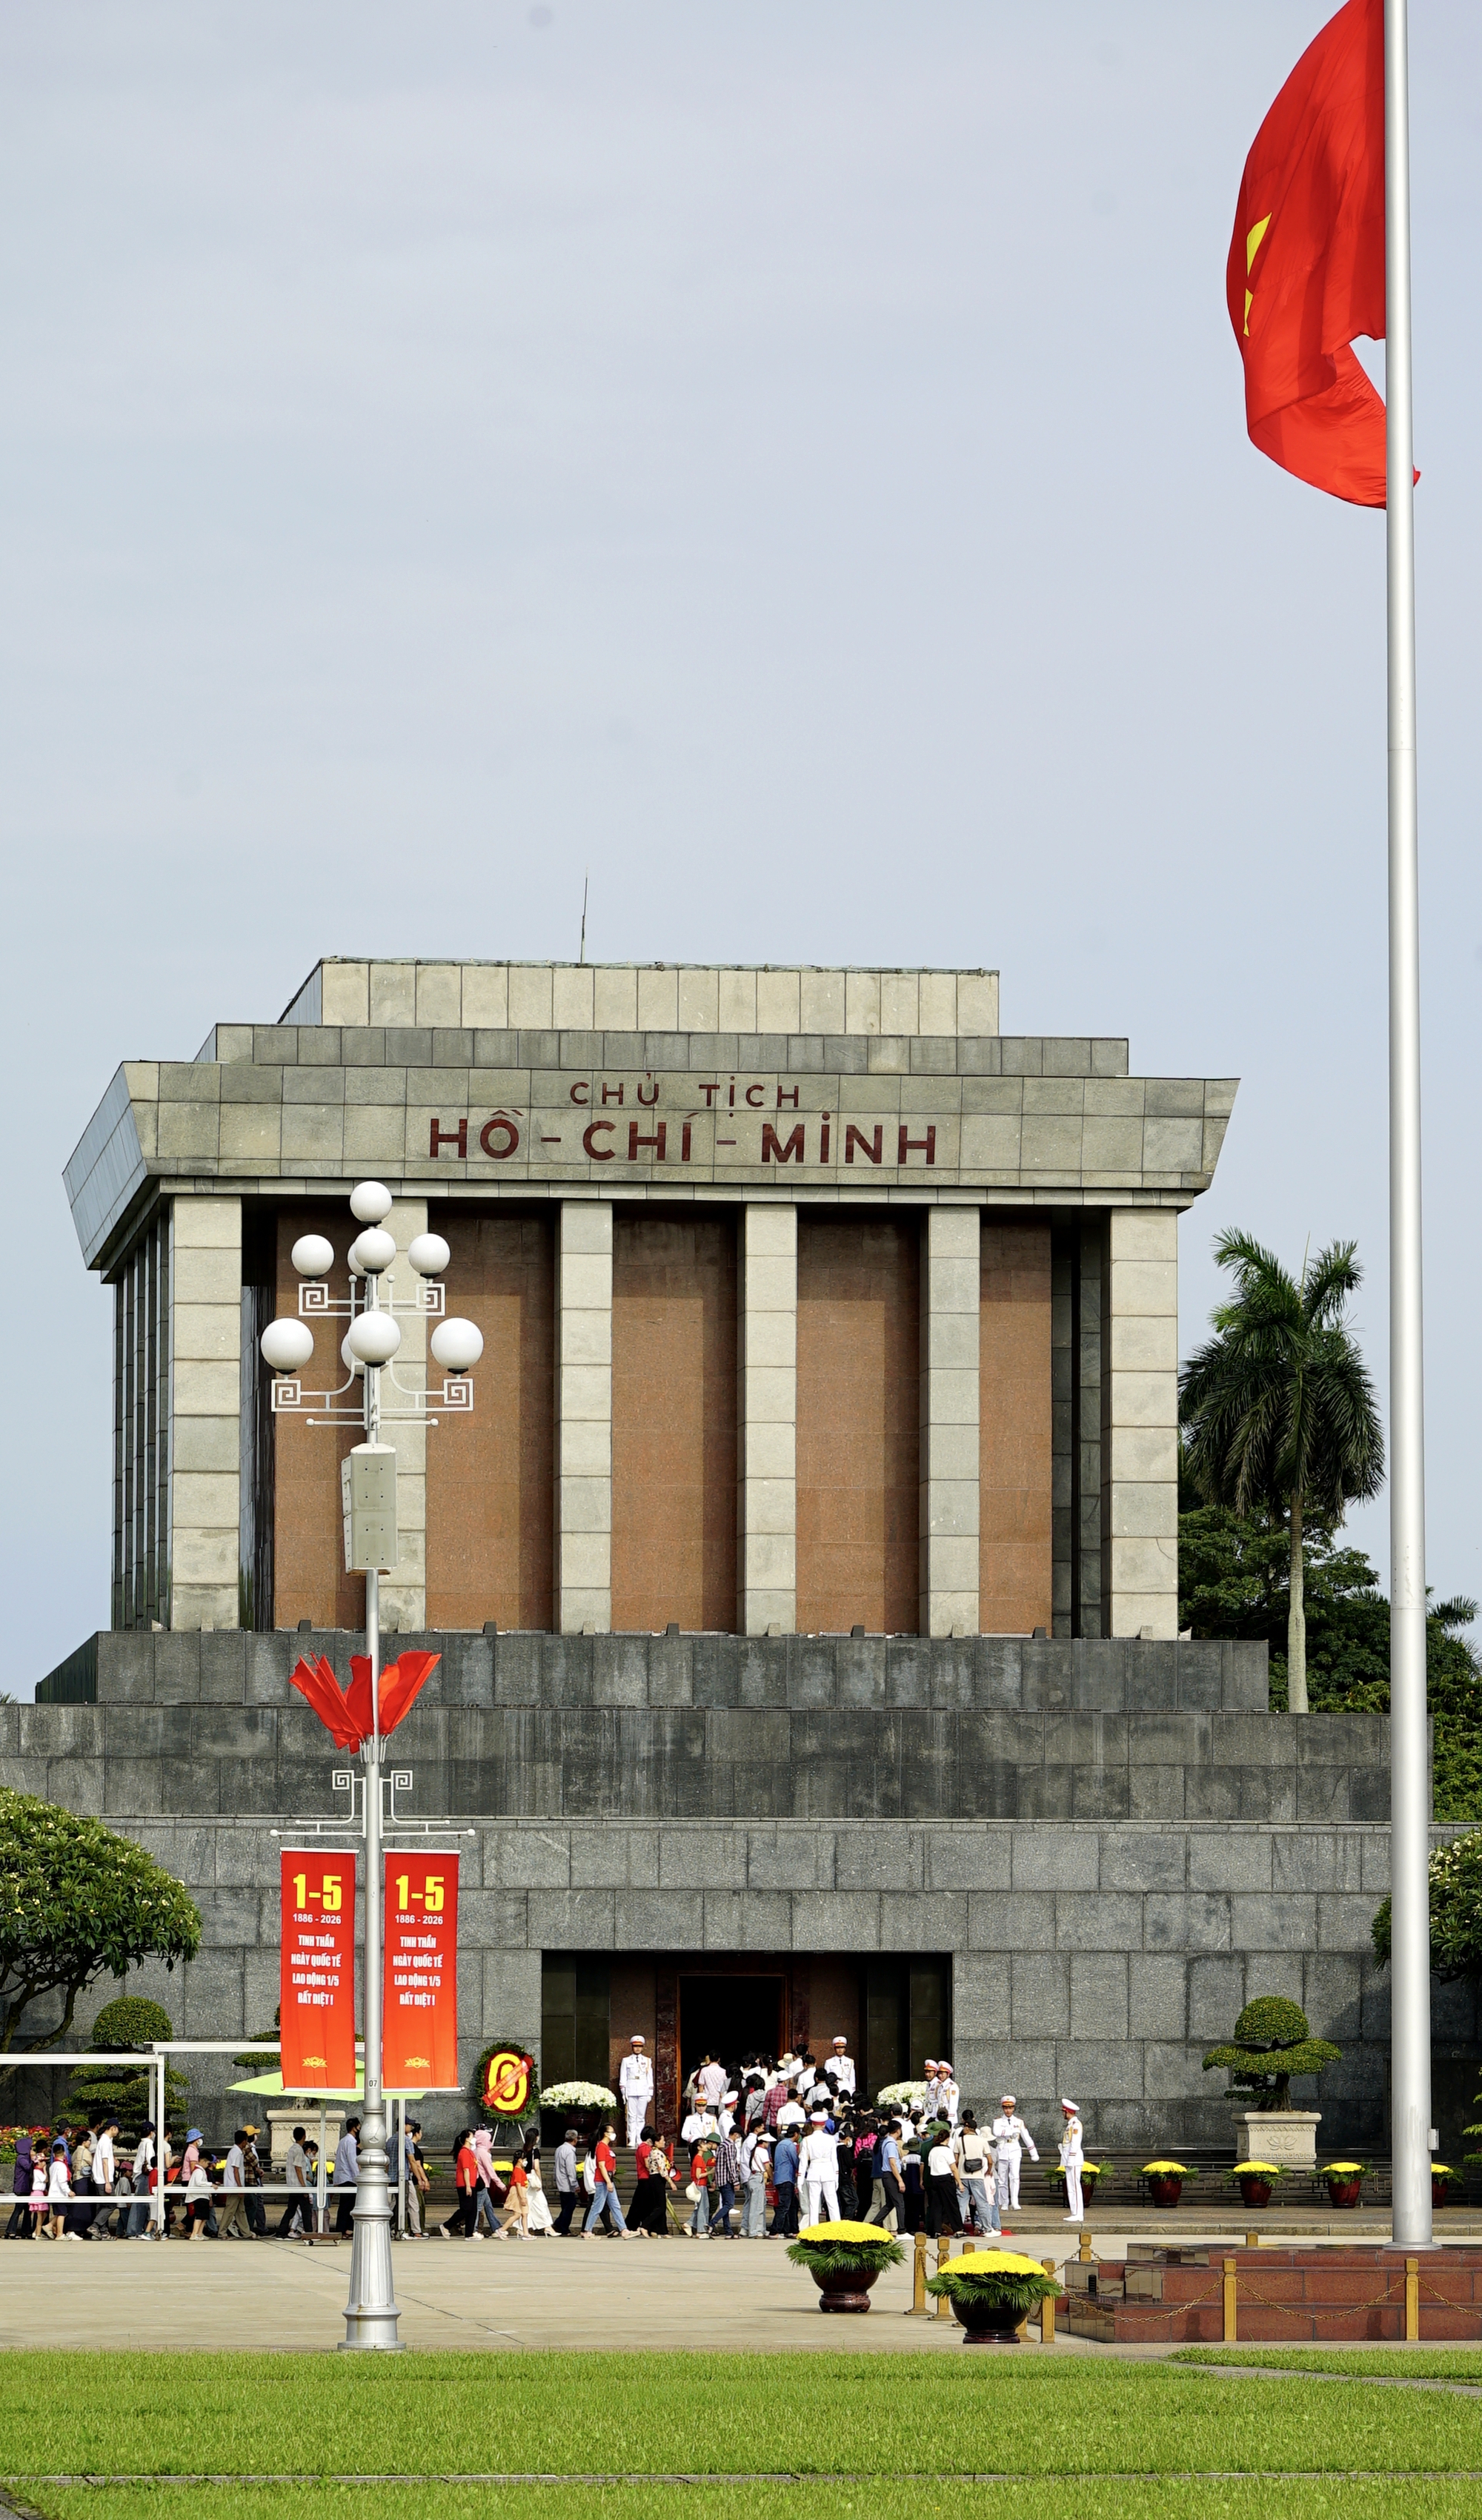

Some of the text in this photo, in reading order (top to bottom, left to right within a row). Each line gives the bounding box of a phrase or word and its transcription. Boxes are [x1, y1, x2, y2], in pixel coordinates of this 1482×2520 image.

[570, 1072, 659, 1105] CHỦ
[430, 1110, 525, 1158] HỒ
[582, 1113, 700, 1161] CHÍ
[293, 1874, 342, 1911] 1-5
[396, 1875, 445, 1911] 1-5
[293, 1913, 313, 1923] 1886
[320, 1914, 342, 1924] 2026
[395, 1914, 415, 1924] 1886
[422, 1915, 443, 1925] 2026
[298, 1934, 315, 1946] TINH
[400, 1936, 416, 1948] TINH
[291, 1952, 342, 1967] NGÀY QUỐC TẾ
[393, 1953, 444, 1968] NGÀY QUỐC TẾ
[293, 1972, 339, 1987] LAO ĐỘNG 1/5
[394, 1973, 441, 1989] LAO ĐỘNG 1/5
[298, 1989, 312, 2004] BẤT
[313, 1992, 329, 2007] DIỆT
[399, 1991, 413, 2005] BẤT
[414, 1992, 431, 2008] DIỆT
